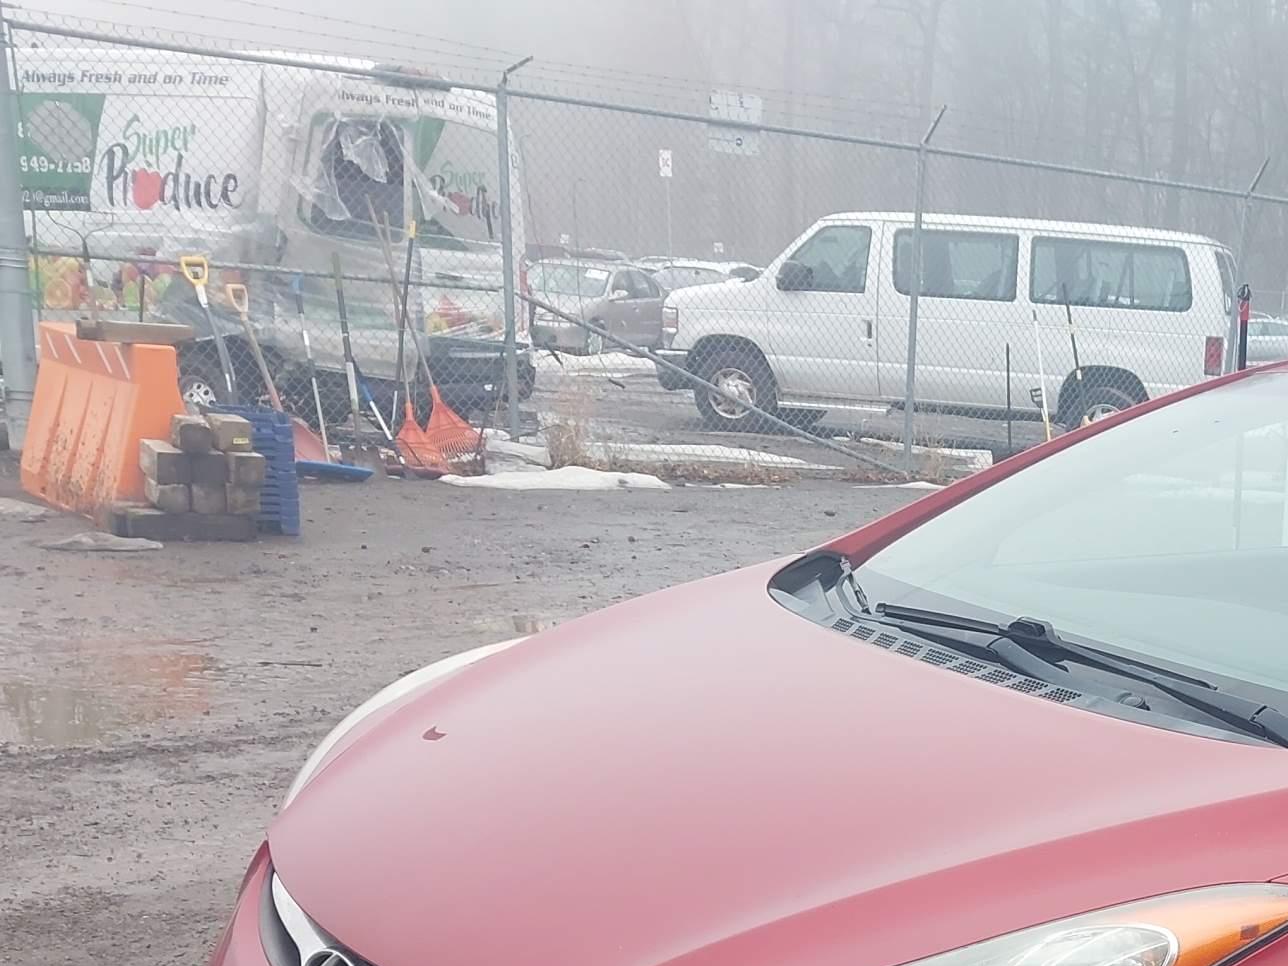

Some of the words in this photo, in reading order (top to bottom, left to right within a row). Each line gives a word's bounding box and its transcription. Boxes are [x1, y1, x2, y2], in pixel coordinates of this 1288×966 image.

[22, 70, 75, 87] Always
[80, 70, 122, 84] Fresh
[127, 71, 158, 85] and
[163, 74, 183, 86] on
[189, 71, 230, 86] Time
[122, 113, 197, 169] Super
[100, 142, 241, 211] Produce
[439, 159, 487, 194] Super
